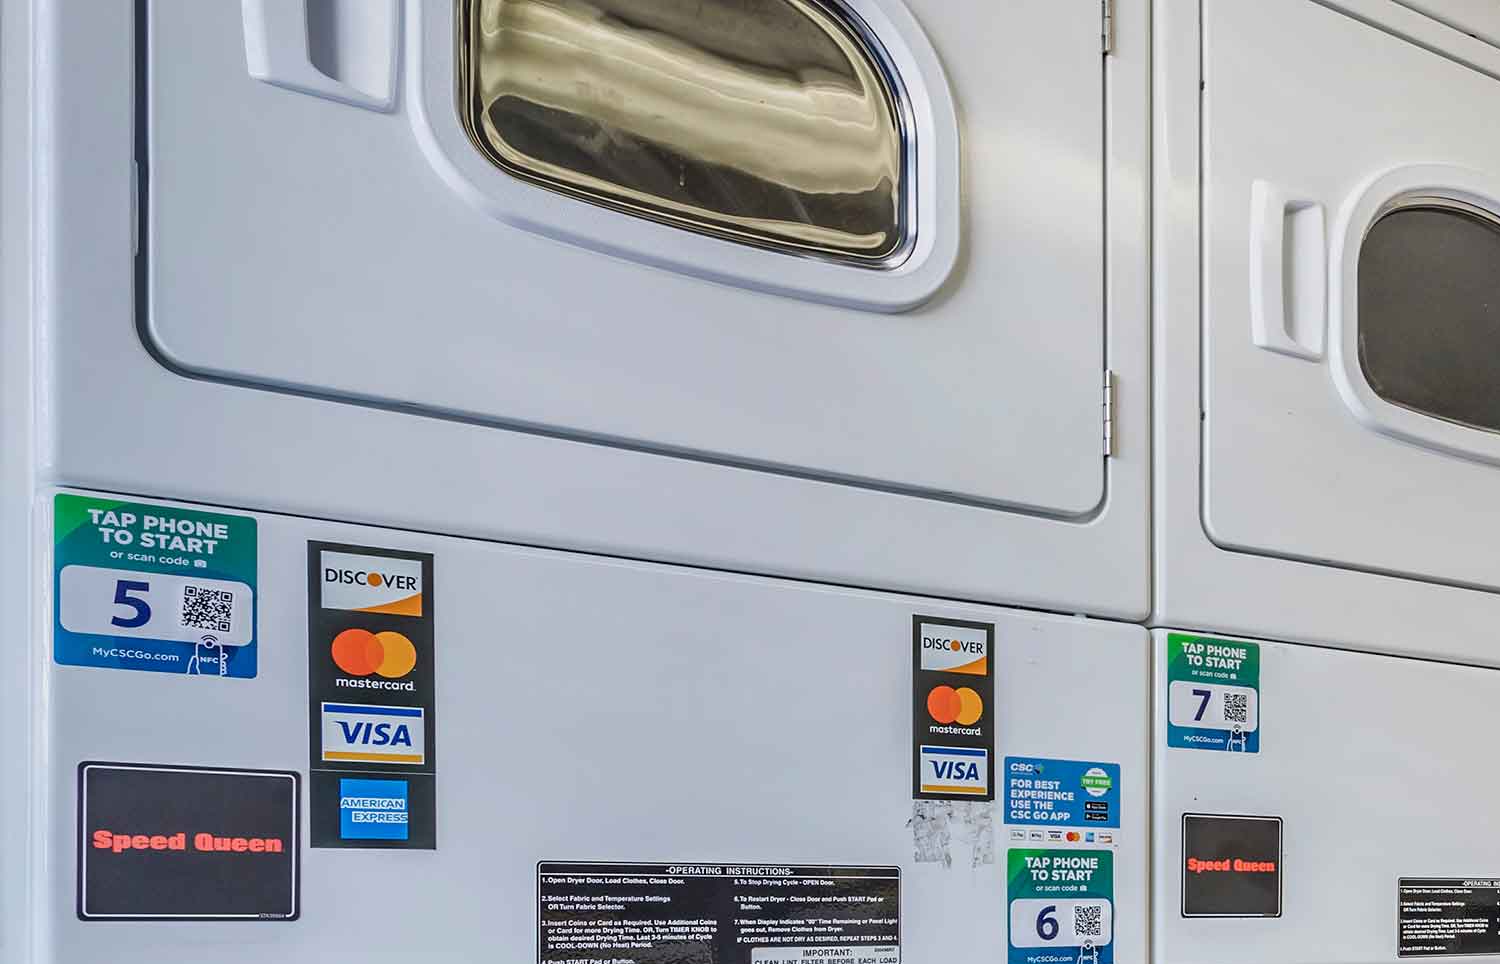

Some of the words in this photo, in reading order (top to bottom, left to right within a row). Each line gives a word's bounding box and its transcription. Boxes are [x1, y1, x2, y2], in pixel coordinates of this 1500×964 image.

[88, 509, 136, 527] TAP
[144, 514, 229, 540] PHONE
[99, 528, 133, 545] TO
[140, 532, 218, 555] START
[127, 553, 155, 563] scan
[159, 555, 190, 566] code
[325, 568, 418, 591] DISCOVER
[111, 579, 152, 628] 5
[923, 637, 984, 654] DISCOVER
[1182, 642, 1204, 653] TAP
[1207, 645, 1247, 660] PHONE
[92, 647, 180, 662] MyCSCGo.com
[200, 656, 219, 664] NFC
[1186, 654, 1203, 665] TO
[1206, 658, 1242, 670] START
[1192, 689, 1211, 721] 7
[335, 720, 412, 747] VISA
[929, 725, 982, 736] mastercard
[929, 760, 979, 781] VISA
[1010, 763, 1033, 772] CSC
[1011, 779, 1032, 788] FOR
[1034, 780, 1061, 790] BEST
[1011, 789, 1074, 801] EXPERIENCE
[341, 798, 404, 810] AMERICAN
[1011, 800, 1031, 809] USE
[1033, 801, 1053, 810] THE
[353, 812, 409, 824] EXPRESS
[1011, 810, 1031, 819] CSC
[1033, 811, 1049, 820] GO
[1050, 812, 1071, 821] APP
[93, 830, 186, 853] Speed
[194, 832, 283, 853] Queen
[1025, 857, 1050, 868] TAP
[1053, 858, 1098, 869] PHONE
[1187, 858, 1230, 874] Speed
[1234, 858, 1275, 872] Queen
[1031, 870, 1049, 880] TO
[1051, 870, 1093, 881] START
[1036, 905, 1059, 941] 6
[1027, 956, 1073, 964] MyCSCGo.com
